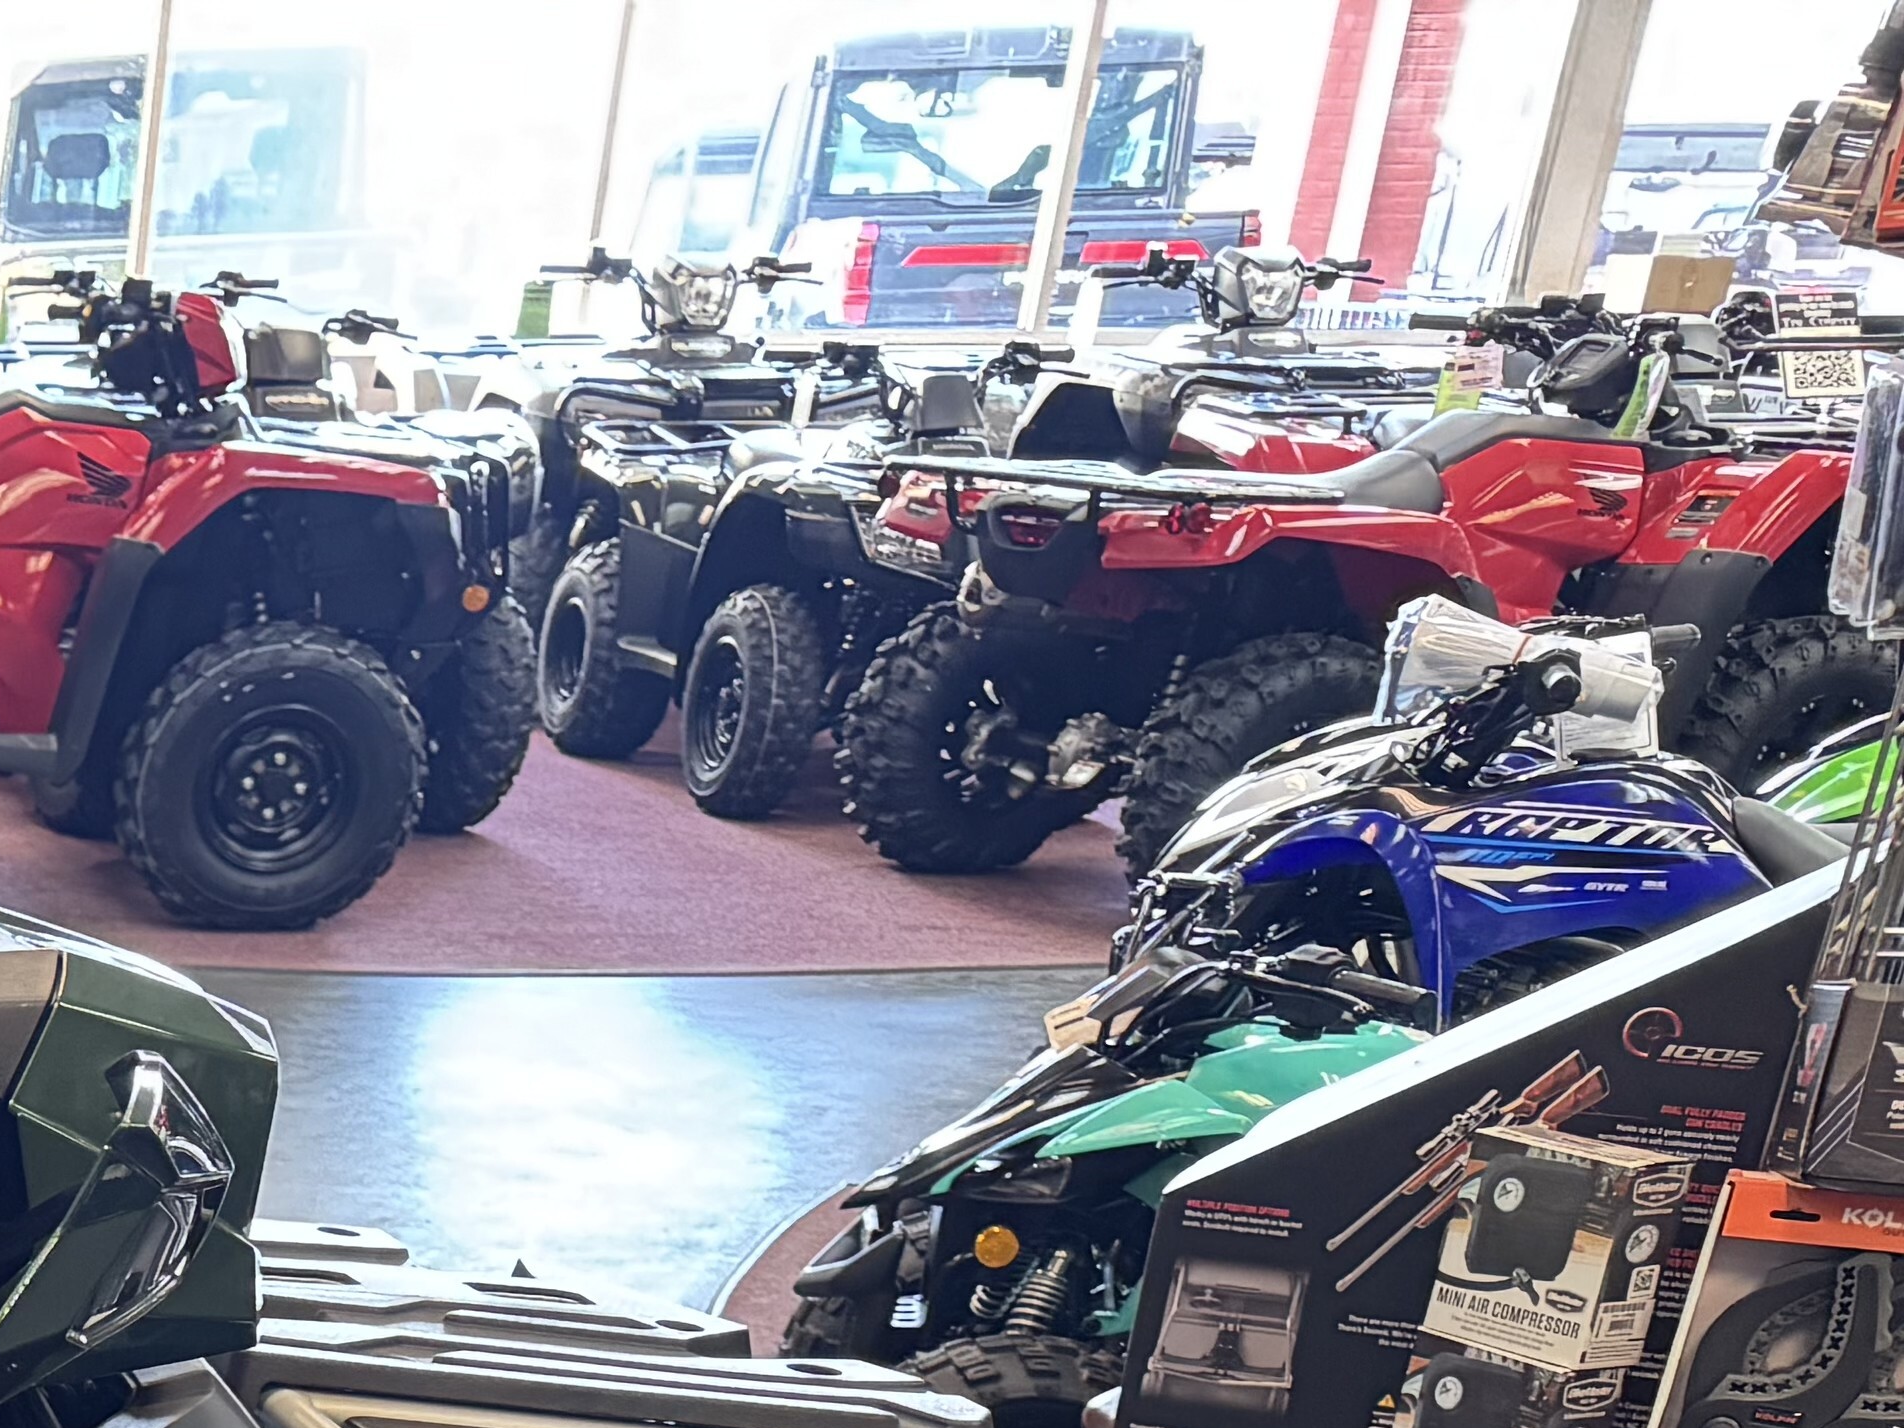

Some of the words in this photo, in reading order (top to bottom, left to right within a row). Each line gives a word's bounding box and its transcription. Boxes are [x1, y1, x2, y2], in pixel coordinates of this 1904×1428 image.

[66, 493, 129, 510] HONDA
[1436, 1285, 1466, 1310] MINI
[1467, 1294, 1490, 1315] AIR
[1491, 1299, 1581, 1340] COMPRESSOR
